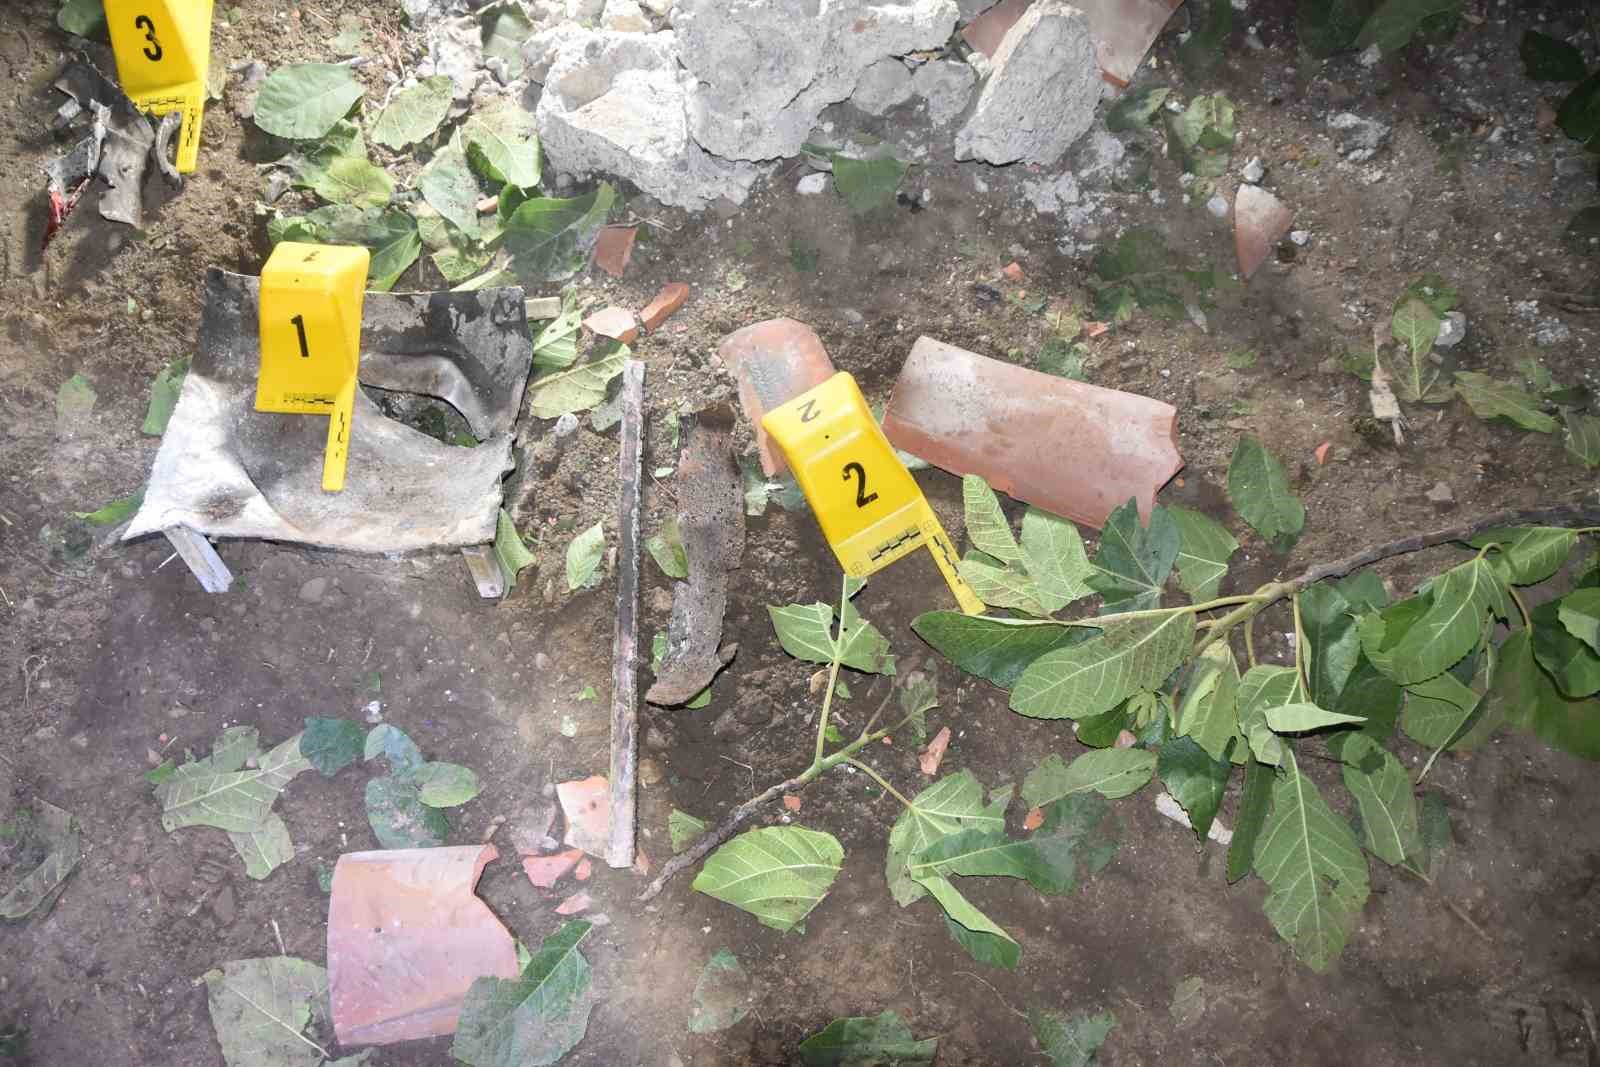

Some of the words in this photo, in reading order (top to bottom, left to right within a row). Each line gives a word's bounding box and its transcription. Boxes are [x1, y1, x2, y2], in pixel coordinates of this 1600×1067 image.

[135, 14, 163, 62] 3
[290, 314, 310, 358] 1
[842, 461, 879, 508] 2
